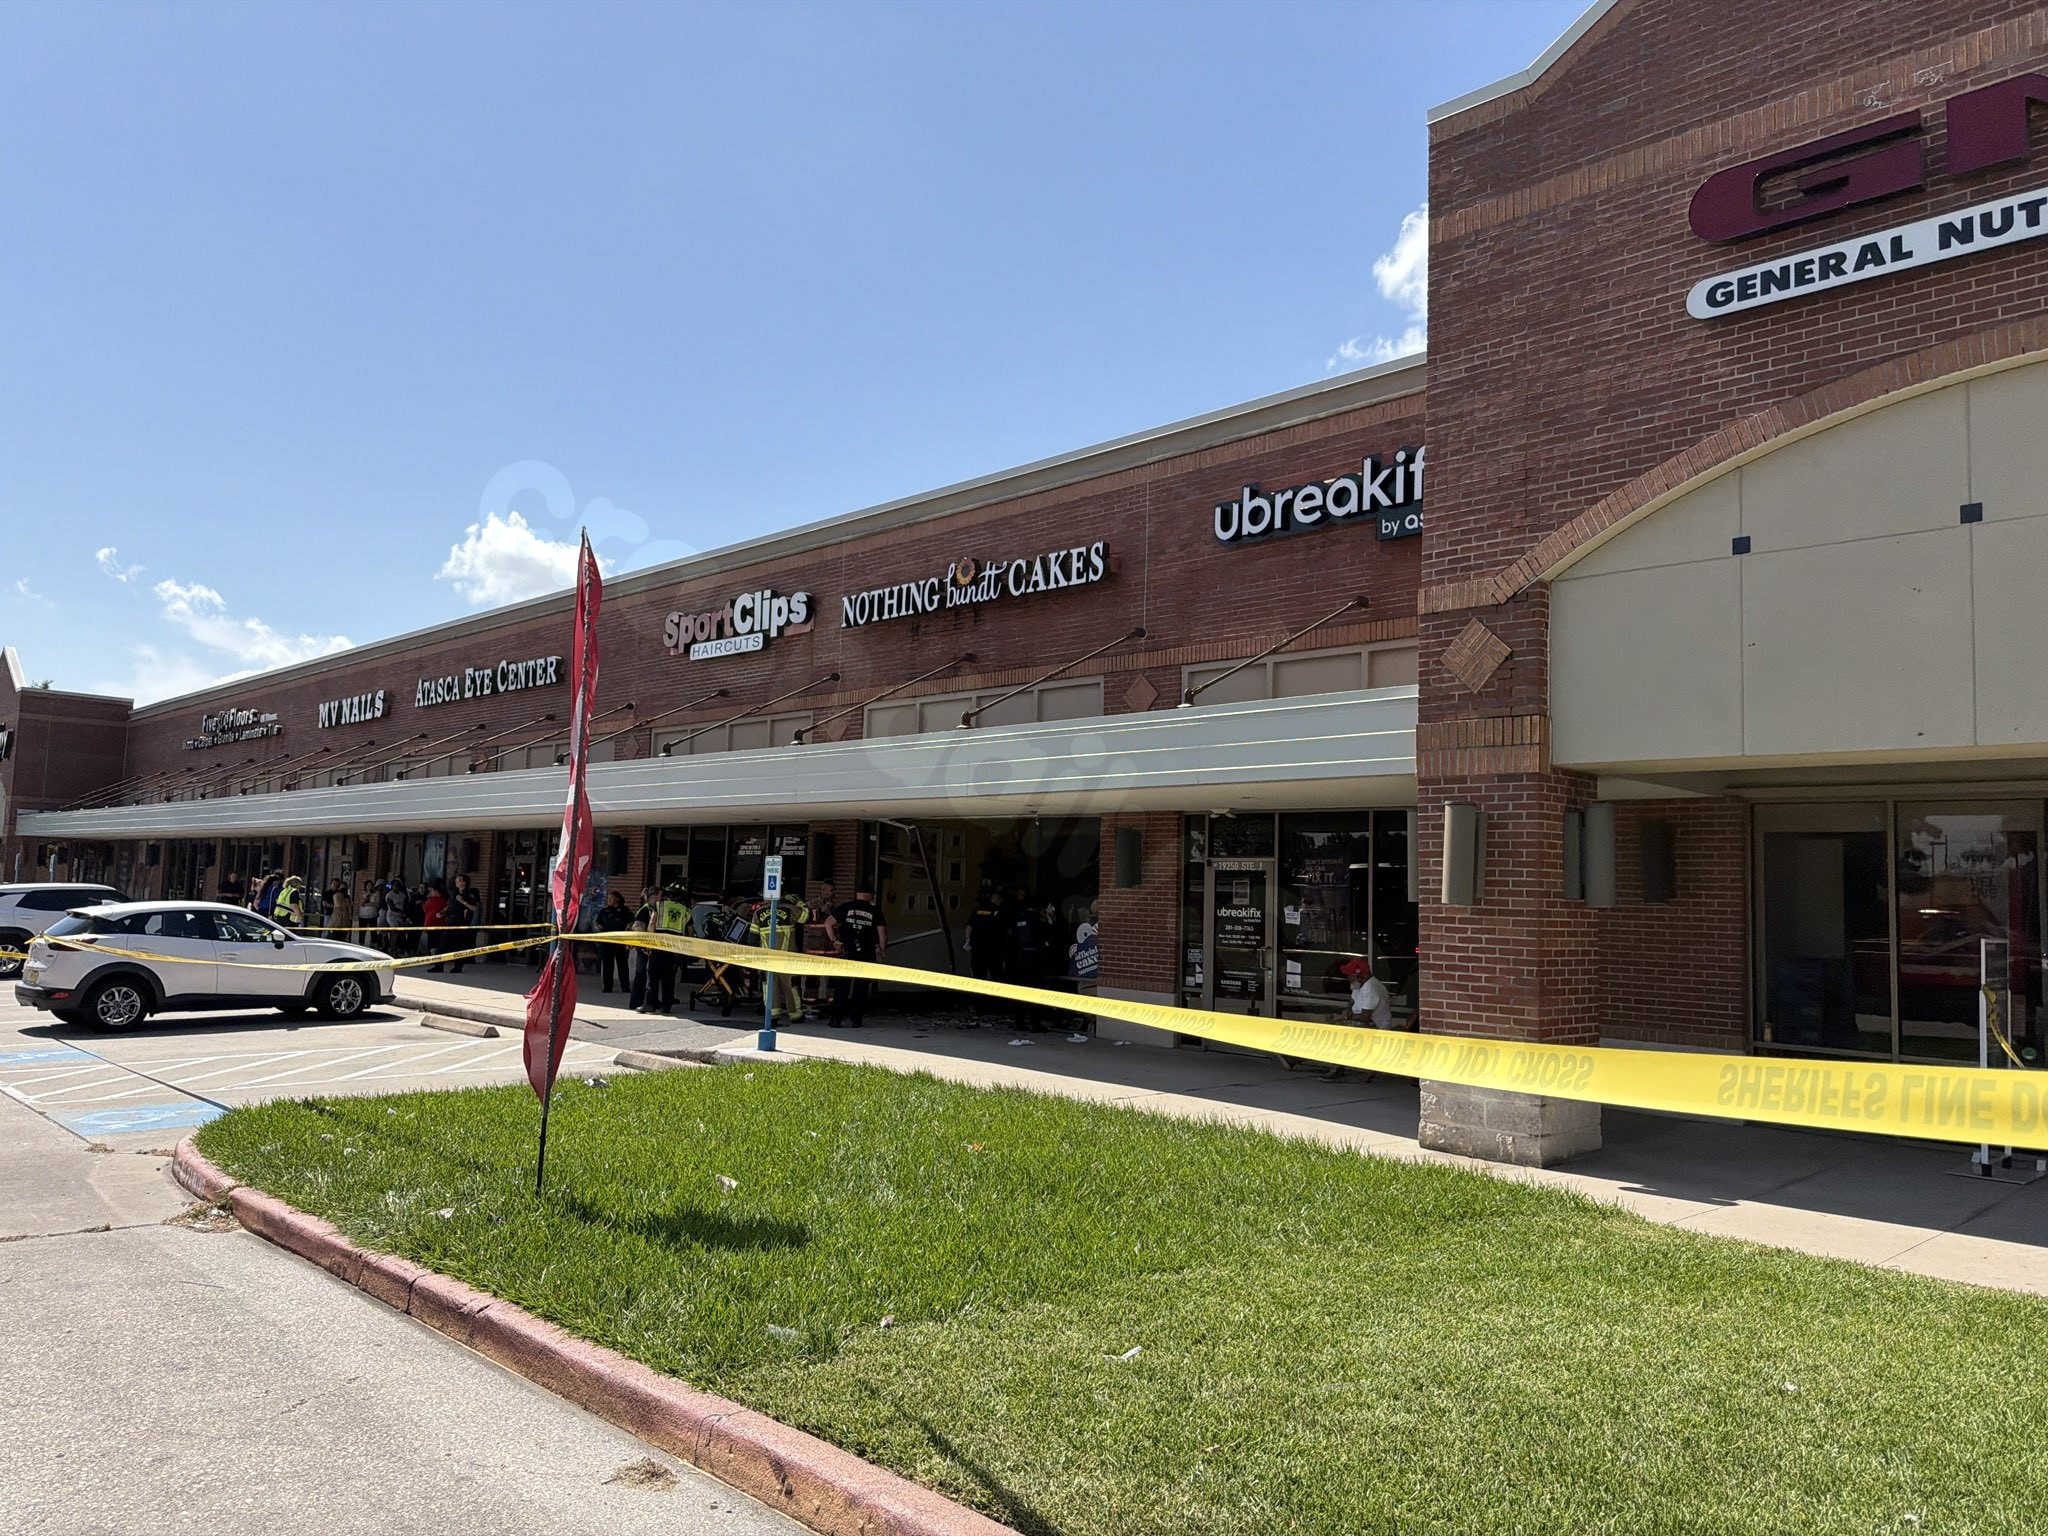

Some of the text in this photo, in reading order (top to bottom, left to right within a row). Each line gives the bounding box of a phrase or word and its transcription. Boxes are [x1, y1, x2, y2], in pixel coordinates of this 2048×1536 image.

[1705, 196, 2048, 309] GENERAL NUT
[1381, 519, 1400, 535] by
[841, 541, 1106, 628] NOTHING bundt CAKES
[691, 634, 762, 659] HAIRCUTS
[415, 656, 558, 707] ATASCA EYE CENTER
[318, 690, 385, 728] MV NAILS
[1216, 907, 1262, 918] ubreakifix
